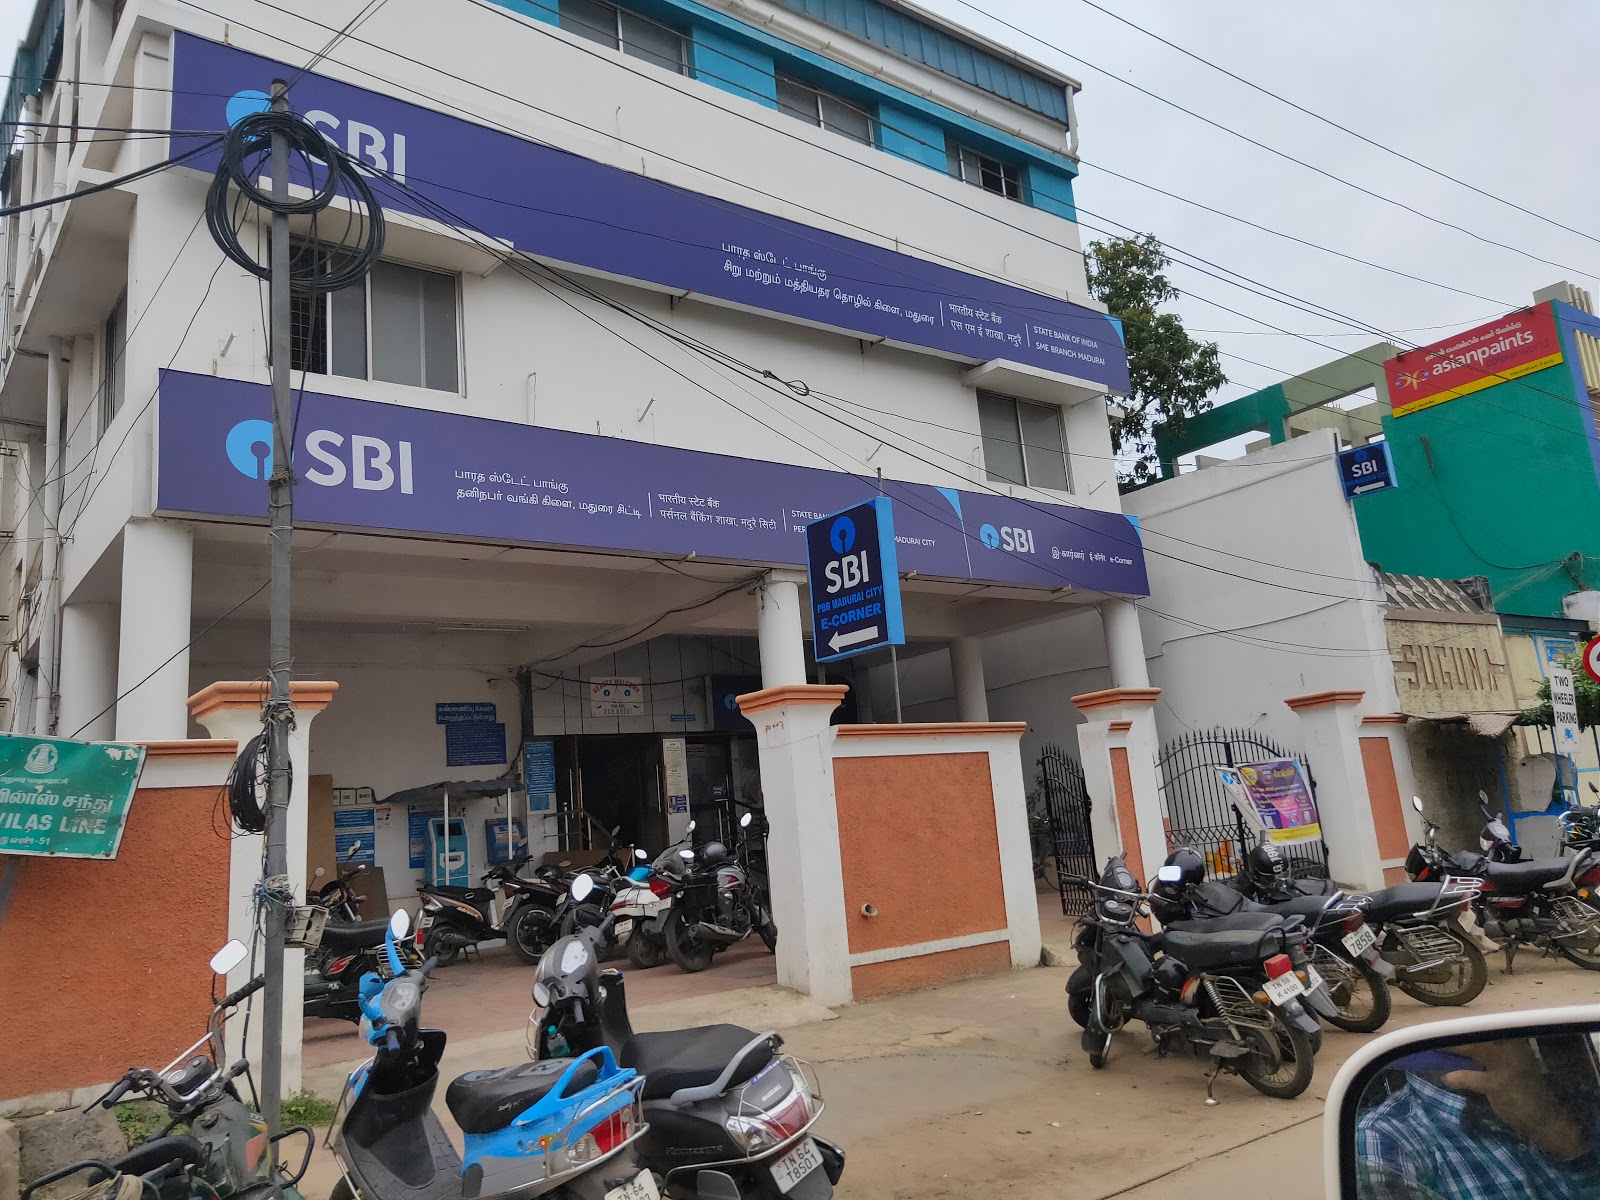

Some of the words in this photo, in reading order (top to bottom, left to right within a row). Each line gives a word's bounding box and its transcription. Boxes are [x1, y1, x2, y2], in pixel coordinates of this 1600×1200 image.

[300, 109, 407, 185] SBI
[722, 242, 751, 260] பாரத
[723, 259, 741, 277] சிறு
[745, 268, 781, 285] மற்றும்
[784, 278, 830, 299] மத்தியதர
[833, 288, 872, 309] தொழில்
[905, 309, 935, 326] மதுரை
[948, 303, 974, 317] भारतीय
[975, 308, 990, 322] स्टेट
[991, 312, 1003, 324] बैंक
[950, 319, 963, 331] एस
[964, 323, 976, 335] एम
[977, 323, 983, 338] ई
[1007, 333, 1022, 348] मदुरै
[1033, 325, 1053, 338] STATE
[1053, 331, 1072, 343] BANK
[1071, 335, 1081, 344] OF
[1080, 338, 1099, 349] INDIA
[1035, 341, 1050, 352] SME
[1050, 345, 1077, 359] BRANCH
[1077, 352, 1106, 366] MADURAI
[1432, 329, 1534, 376] asianpaints
[305, 429, 414, 495] SBI
[1351, 459, 1378, 477] SBI
[455, 469, 486, 484] பாரத
[489, 471, 531, 487] ஸ்டேட்
[533, 479, 569, 494] பாங்கு
[456, 486, 503, 503] தனிநபர்
[507, 492, 539, 506] வங்கி
[579, 501, 614, 516] மதுரை
[616, 503, 643, 520] சிட்டி
[657, 493, 687, 506] भारतीय
[688, 495, 706, 508] स्टेट
[707, 496, 720, 509] बैंक
[659, 507, 688, 521] पर्सनल
[715, 515, 739, 528] शाखा,
[740, 516, 757, 531] मदुरै
[759, 517, 777, 530] सिटी
[791, 510, 813, 519] STATE
[813, 512, 830, 520] BA
[921, 538, 936, 547] CITY
[1000, 526, 1036, 554] SBI
[825, 550, 870, 594] SBI
[1109, 556, 1133, 565] e-Corner
[817, 603, 831, 614] PBB
[832, 591, 864, 610] MADURAI
[865, 585, 883, 597] CITY
[820, 602, 882, 630] E-CORNER
[1553, 675, 1569, 687] TWO
[1553, 692, 1575, 706] WHEELER
[1555, 711, 1577, 725] PARKING
[59, 815, 108, 835] LINE
[1349, 931, 1374, 955] 7858
[1271, 981, 1283, 990] TN
[1276, 991, 1285, 999] K
[1284, 983, 1299, 996] 4100
[761, 1084, 783, 1102] SUZUKI
[782, 1153, 797, 1172] TN
[796, 1141, 812, 1157] 64
[786, 1153, 819, 1183] T8501
